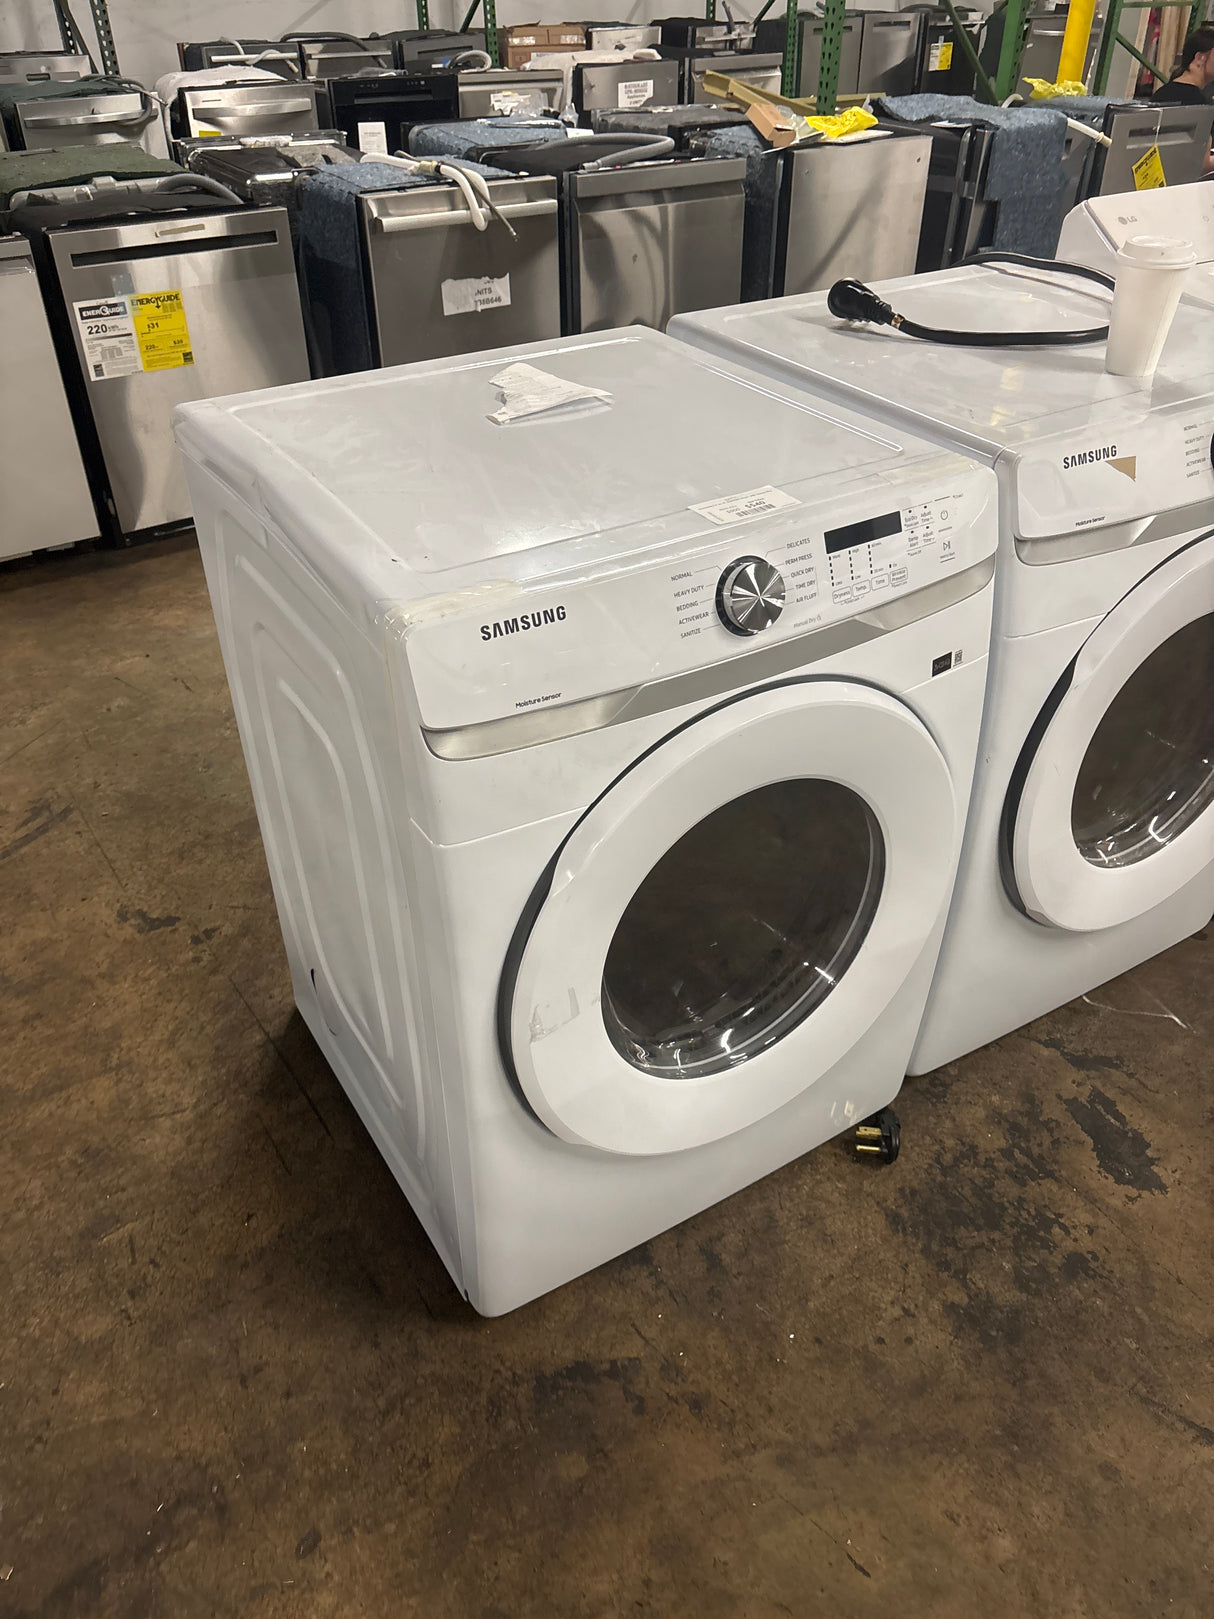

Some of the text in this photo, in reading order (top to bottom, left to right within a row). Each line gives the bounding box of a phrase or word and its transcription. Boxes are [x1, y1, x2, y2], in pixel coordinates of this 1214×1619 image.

[474, 287, 493, 296] NITS
[86, 323, 108, 335] 220
[1063, 445, 1118, 470] SAMSUNG
[786, 537, 811, 550] DELICATES
[784, 552, 813, 566] PERM PRESS
[670, 571, 693, 582] NORMAL
[790, 566, 814, 579] QUICK DRY
[795, 579, 816, 590] TIME DRY
[673, 584, 705, 599] HEAVY DUTY
[795, 592, 817, 604] AIR FLUFF
[676, 600, 699, 612] BEDDING
[480, 605, 567, 641] SAMSUNG
[678, 611, 710, 625] ACTIVEWEAR
[680, 627, 702, 639] SANITIZE
[515, 692, 562, 709] Moisture Sensor
